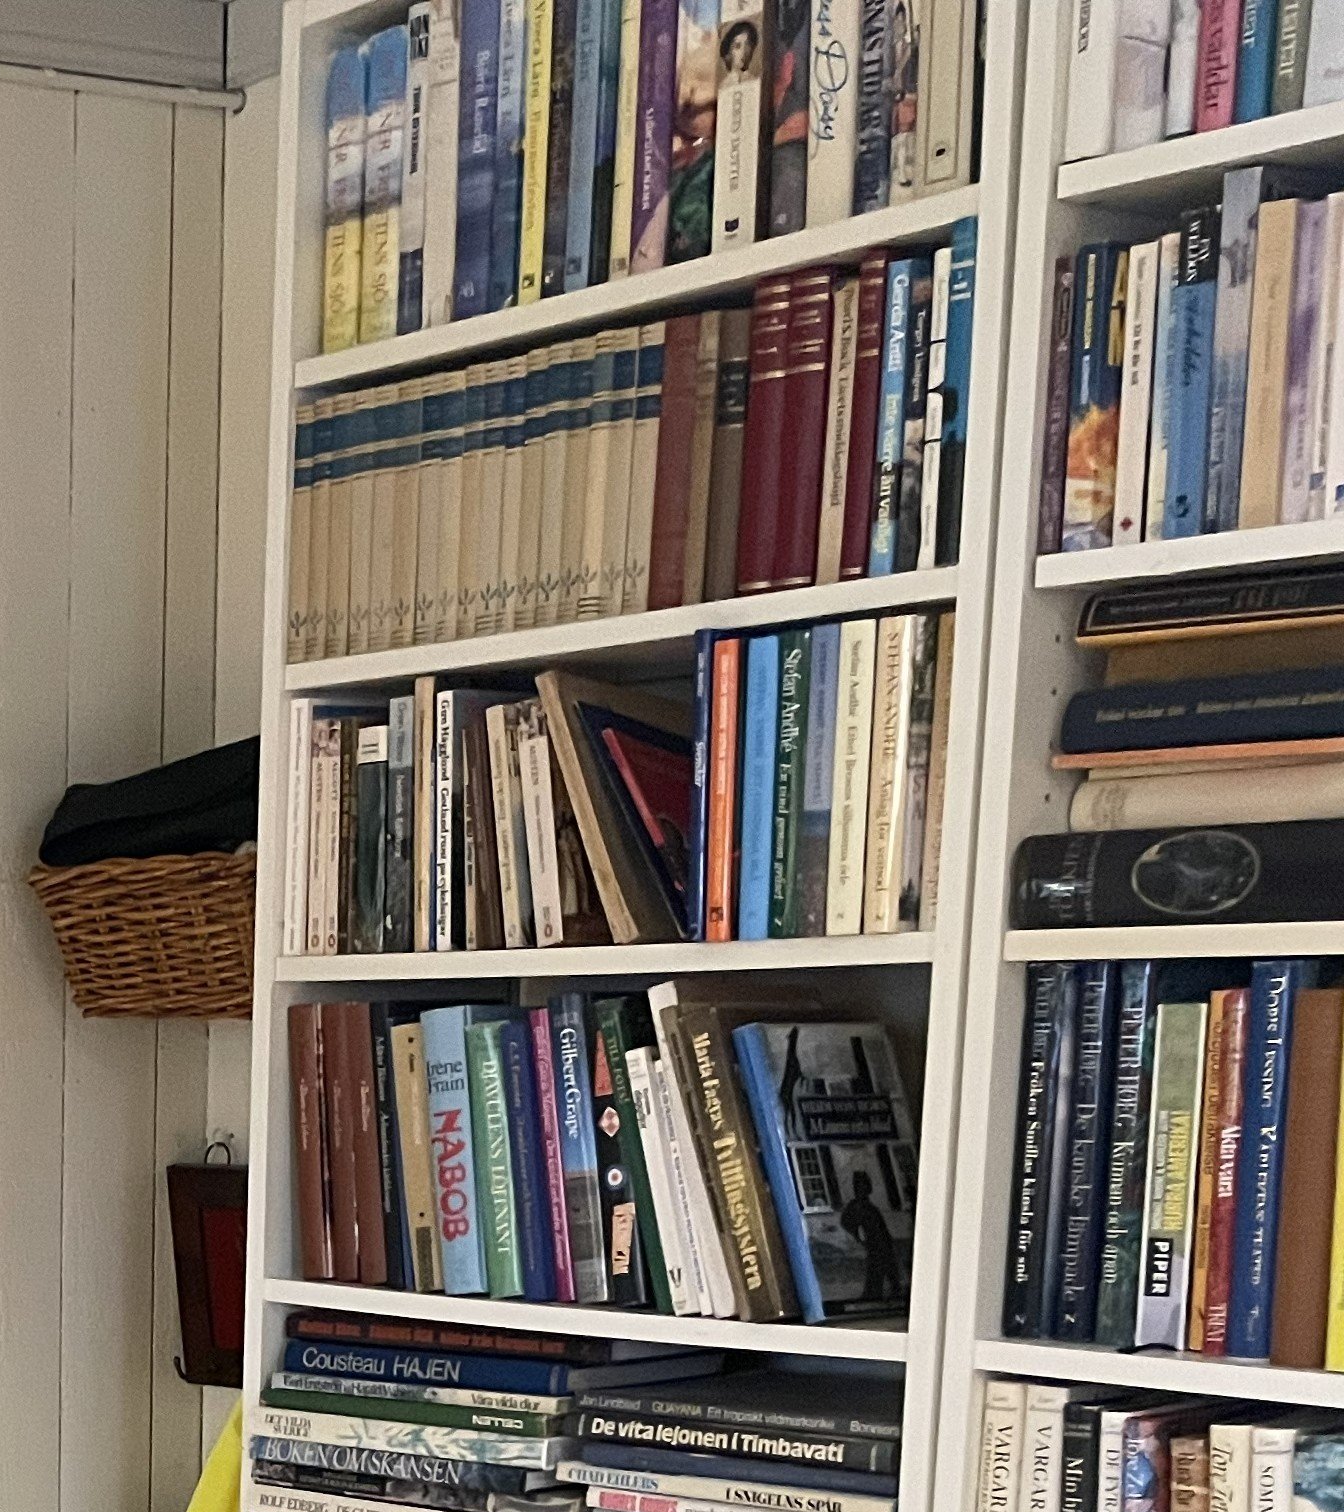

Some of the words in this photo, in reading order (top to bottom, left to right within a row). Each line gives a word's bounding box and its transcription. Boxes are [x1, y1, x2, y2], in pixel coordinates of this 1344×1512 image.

[813, 40, 849, 141] Daisy
[890, 273, 909, 325] Gerda
[880, 475, 900, 499] än
[781, 648, 802, 698] Stefan
[440, 699, 450, 725] Gun
[780, 700, 800, 751] Andhé
[438, 786, 450, 834] Gotland
[558, 1027, 580, 1088] Gilbert
[1120, 1005, 1144, 1068] PETER
[427, 1059, 464, 1077] Irene
[1026, 1060, 1046, 1116] Fröken
[563, 1086, 582, 1140] Grape
[1076, 1102, 1097, 1131] De
[1022, 1120, 1043, 1173] Smillas
[429, 1107, 471, 1244] NABOB
[1109, 1139, 1136, 1206] Kvinnan
[1019, 1177, 1040, 1225] känsla
[1018, 1227, 1035, 1251] för
[1105, 1210, 1129, 1239] och
[1015, 1254, 1031, 1282] snö
[1102, 1243, 1122, 1284] apan
[1151, 1239, 1171, 1293] PIPER
[302, 1346, 385, 1375] Cousteau
[392, 1354, 462, 1383] HAJEN
[264, 1440, 327, 1468] BOKEN
[332, 1449, 369, 1471] OM
[368, 1451, 461, 1484] SKANSEN
[591, 1418, 614, 1435] De
[617, 1420, 654, 1440] vita
[655, 1423, 728, 1450] lejonen
[740, 1433, 844, 1463] Timbavati
[1063, 1456, 1086, 1494] Min
[1210, 1444, 1234, 1484] Tore
[259, 1493, 285, 1508] ROLF
[733, 1487, 804, 1509] SNIGELNS
